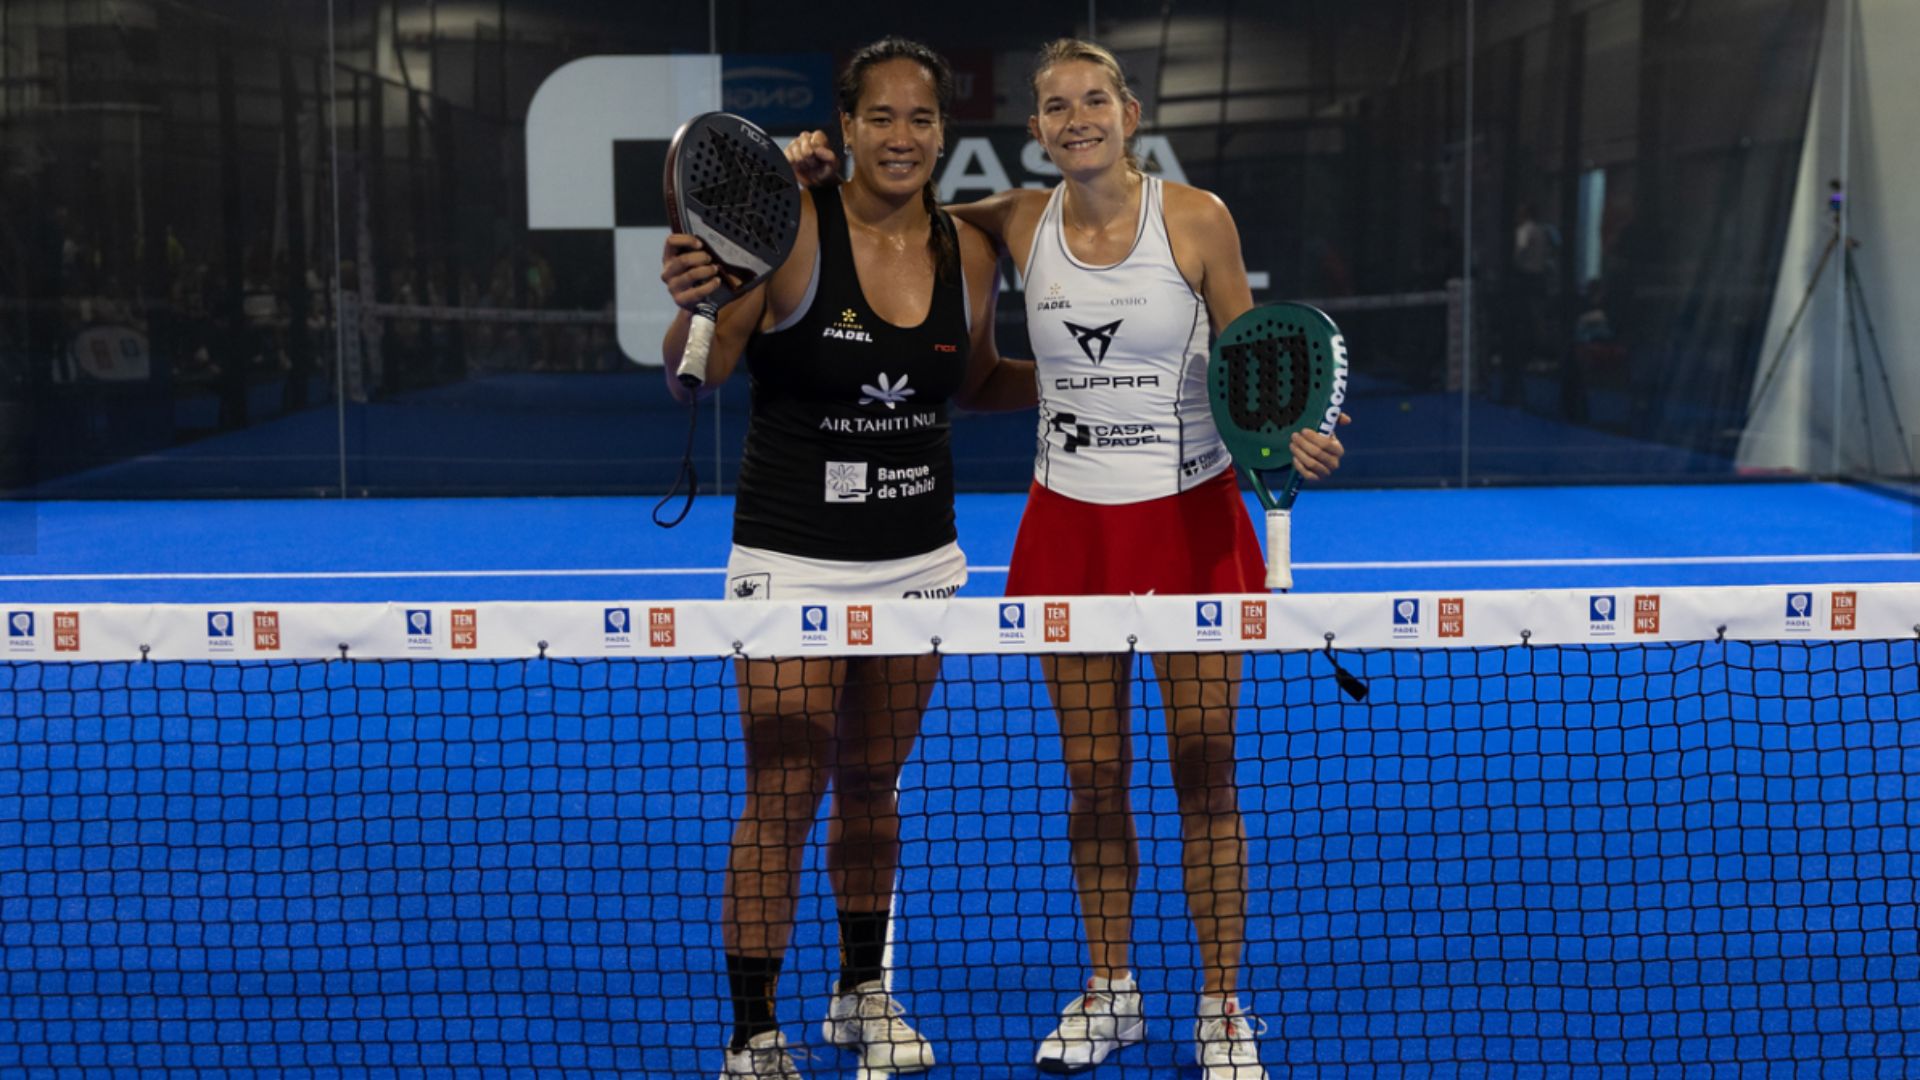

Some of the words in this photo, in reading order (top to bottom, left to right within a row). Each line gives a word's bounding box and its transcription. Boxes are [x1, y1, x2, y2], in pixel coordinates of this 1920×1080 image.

[1038, 300, 1072, 311] PADEL
[823, 327, 873, 343] PADEL
[1055, 375, 1159, 390] CUPRA
[819, 416, 854, 433] AIR
[854, 416, 909, 432] TAHITI
[912, 412, 936, 428] NUI
[1095, 424, 1156, 437] CASA
[1097, 434, 1171, 447] PADEL
[878, 465, 929, 481] Banque
[878, 484, 897, 499] de
[900, 477, 936, 497] Tahiti
[1638, 599, 1656, 611] TEN
[1835, 596, 1853, 608] TEN
[1047, 607, 1066, 619] TEN
[1244, 605, 1262, 617] TEN
[1442, 603, 1460, 615] TEN
[57, 616, 75, 628] TEN
[257, 616, 275, 627] TEN
[454, 614, 473, 626] TEN
[653, 613, 671, 625] TEN
[850, 610, 868, 622] TEN
[1835, 614, 1852, 626] NIS
[1244, 623, 1262, 635] NIS
[1442, 621, 1460, 633] NIS
[1638, 618, 1655, 630] NIS
[653, 630, 672, 642] NIS
[851, 629, 868, 641] NIS
[1047, 626, 1066, 638] NIS
[57, 634, 76, 647] NIS
[258, 634, 276, 647] NIS
[455, 632, 473, 645] NIS
